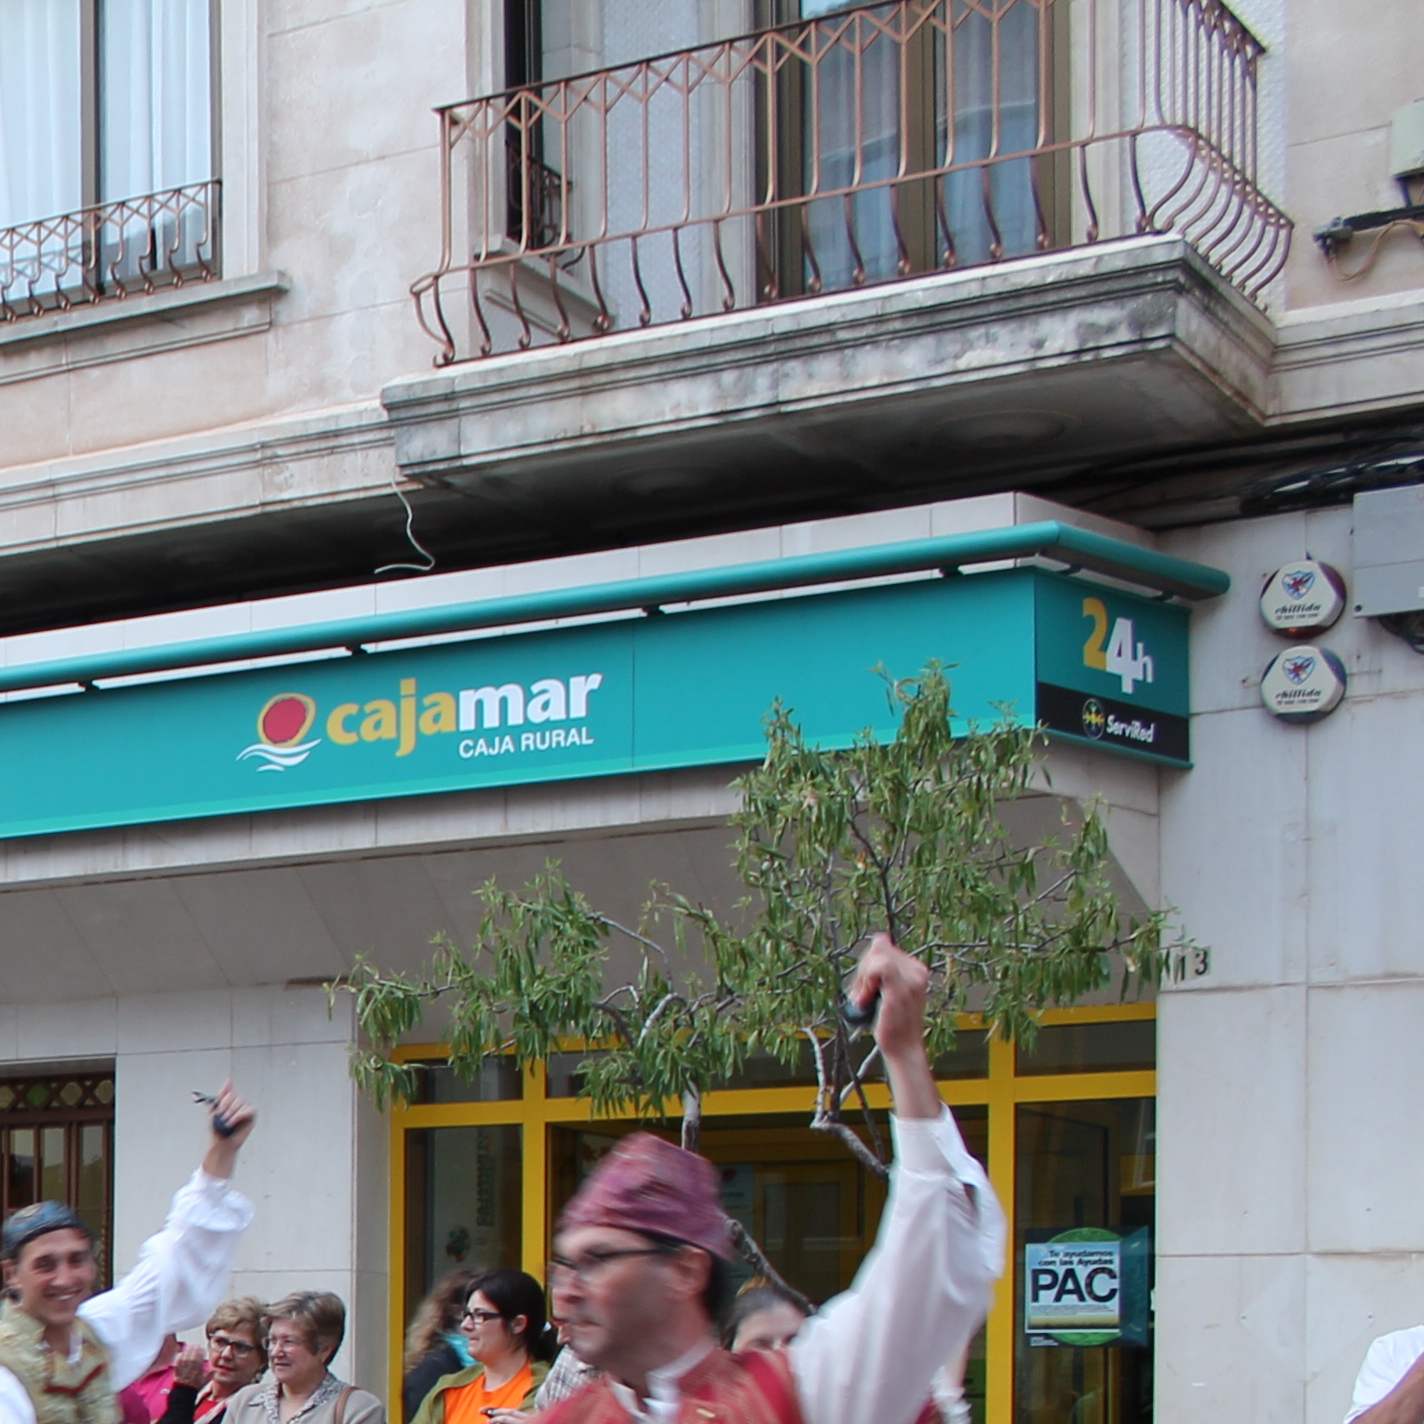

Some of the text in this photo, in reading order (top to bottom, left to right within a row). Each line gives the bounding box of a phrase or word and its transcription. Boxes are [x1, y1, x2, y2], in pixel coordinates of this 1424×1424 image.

[1082, 597, 1153, 694] 24h
[326, 673, 603, 757] cajamar
[1106, 714, 1155, 743] ServiRed
[459, 727, 595, 759] CAJA RURAL
[1031, 1267, 1119, 1303] PAC
